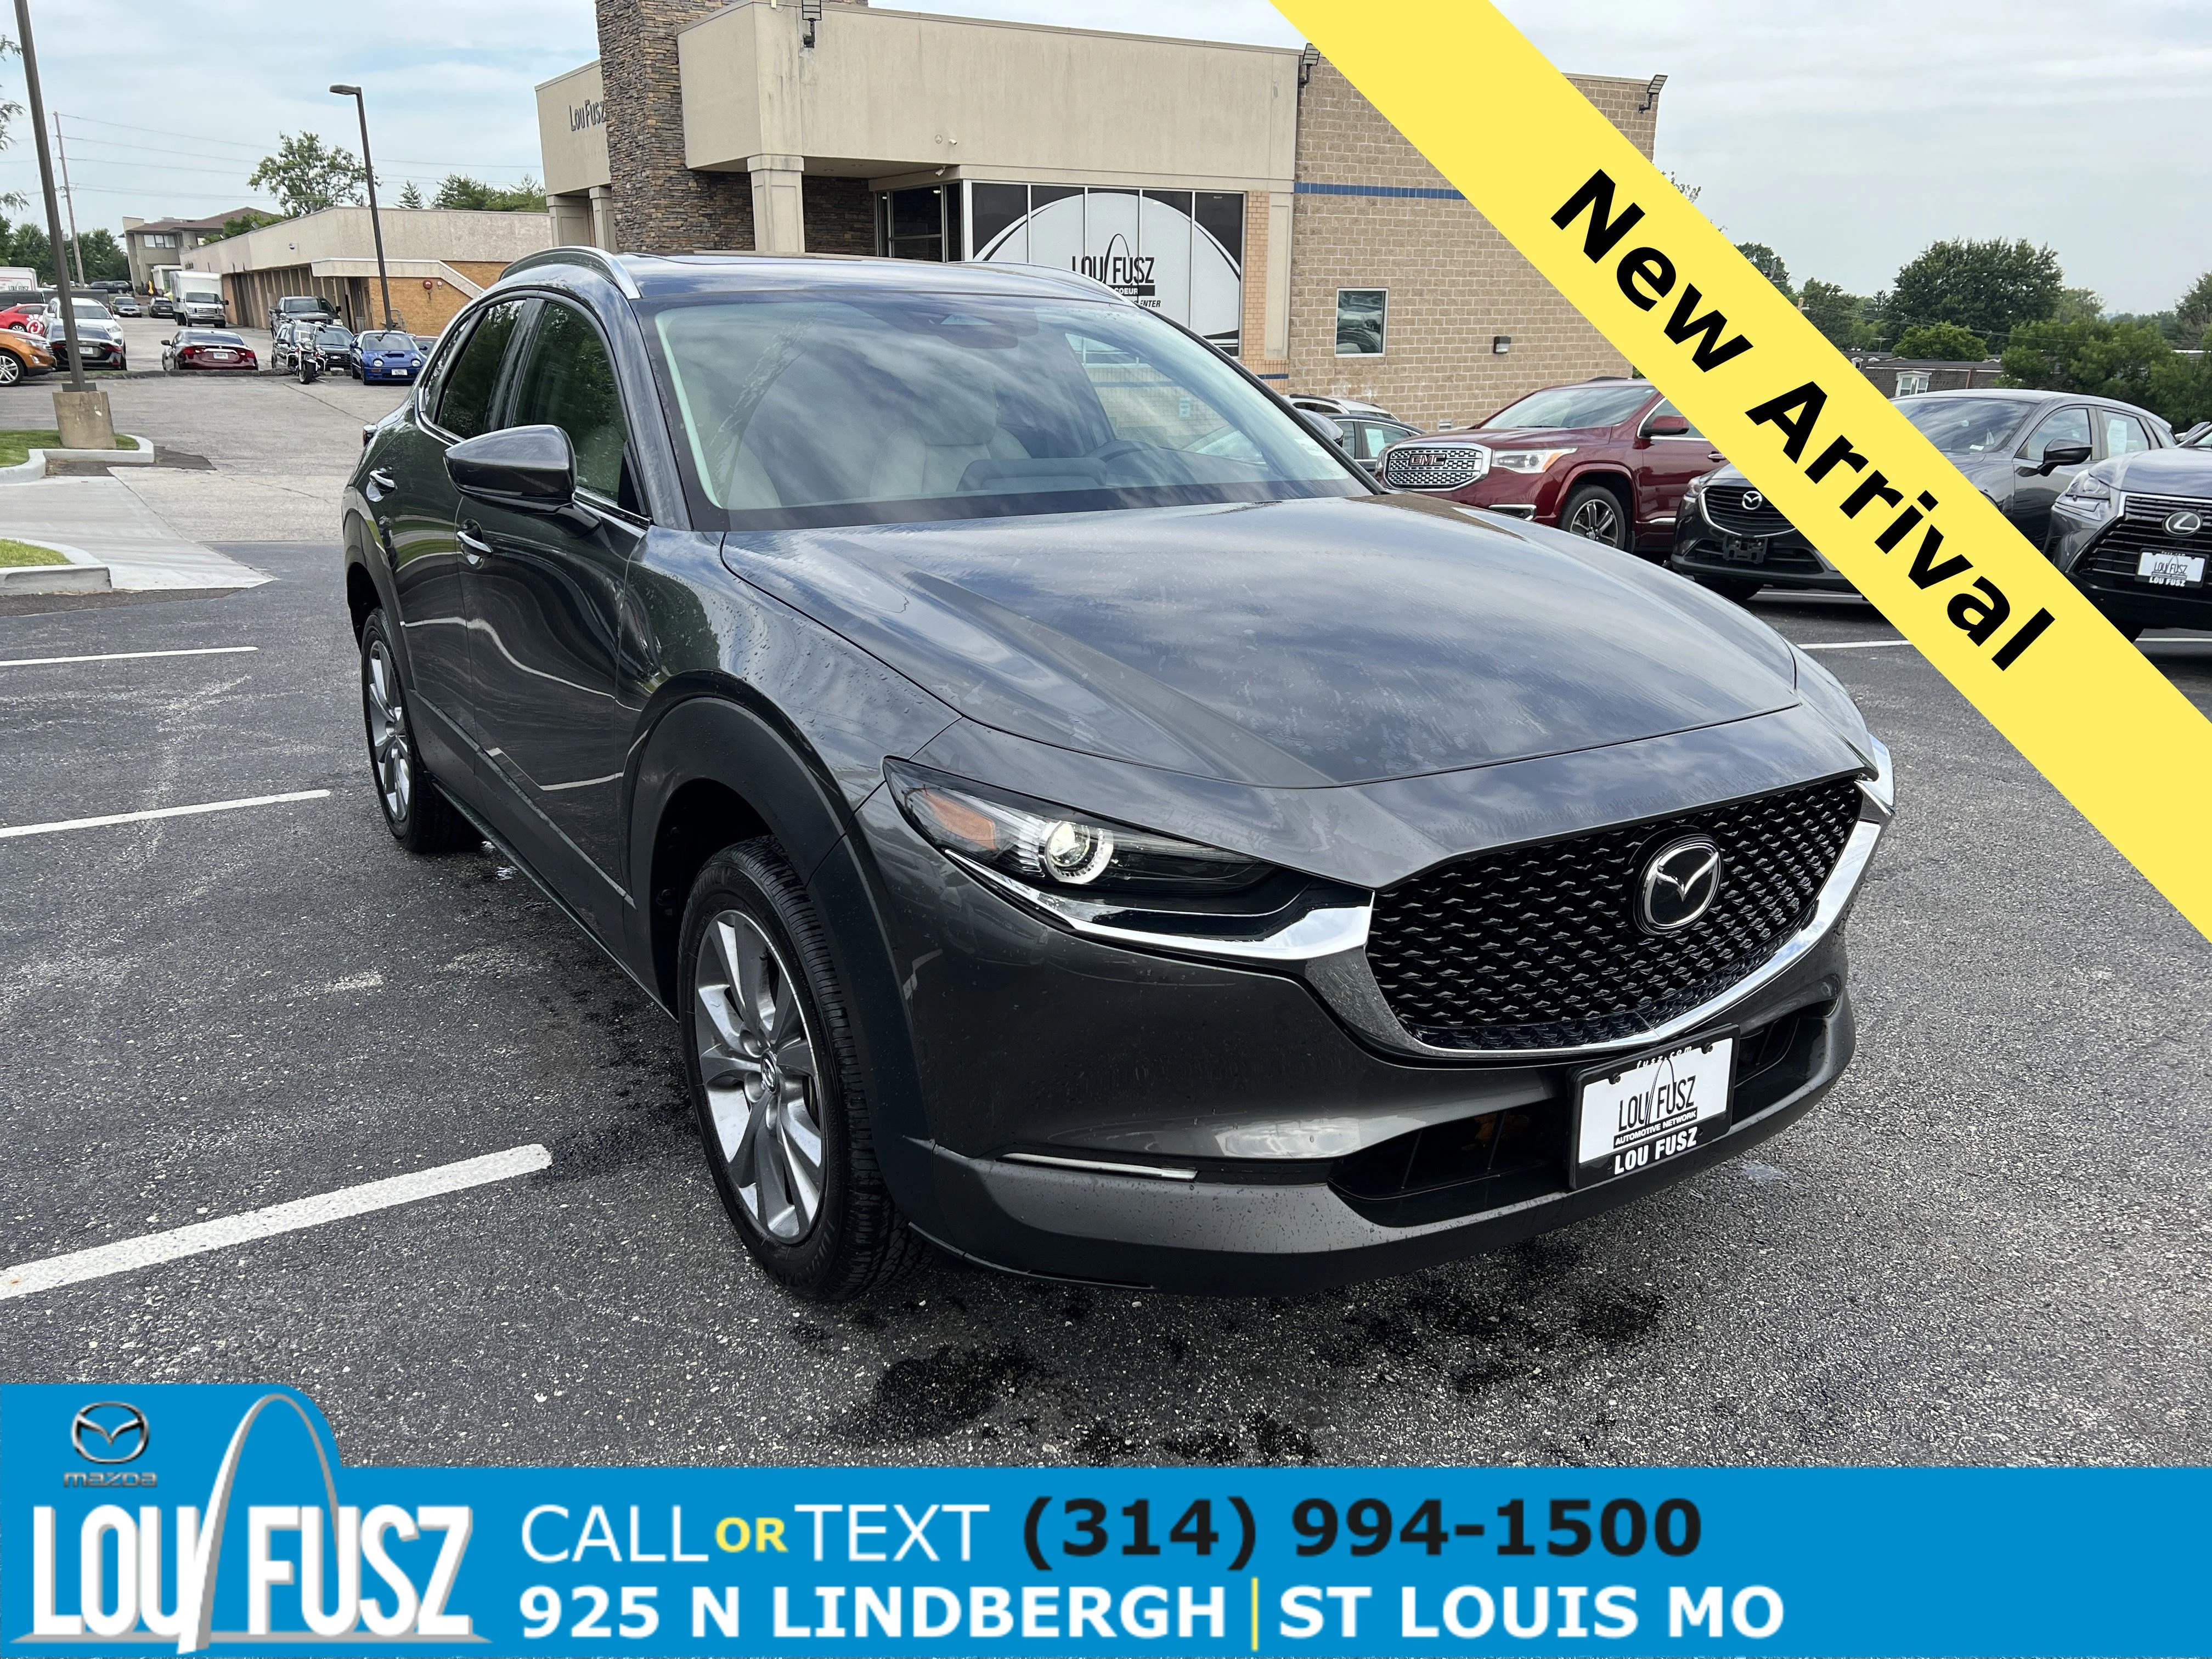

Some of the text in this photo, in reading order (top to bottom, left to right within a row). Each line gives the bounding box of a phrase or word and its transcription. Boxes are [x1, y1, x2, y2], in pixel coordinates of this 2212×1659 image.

[1113, 257, 1155, 284] FUSZ
[1410, 454, 1446, 466] GMC
[2154, 562, 2188, 574] LOU FUSZ
[2149, 576, 2165, 585] LOU
[2165, 578, 2186, 587] FUSZ
[1637, 1045, 1692, 1069] fusz.com
[1618, 1075, 1696, 1133] LOU FUSZ
[1615, 1109, 1697, 1146] AUTOMOTIVE NETWORK
[1614, 1126, 1699, 1175] LOU FUSZ
